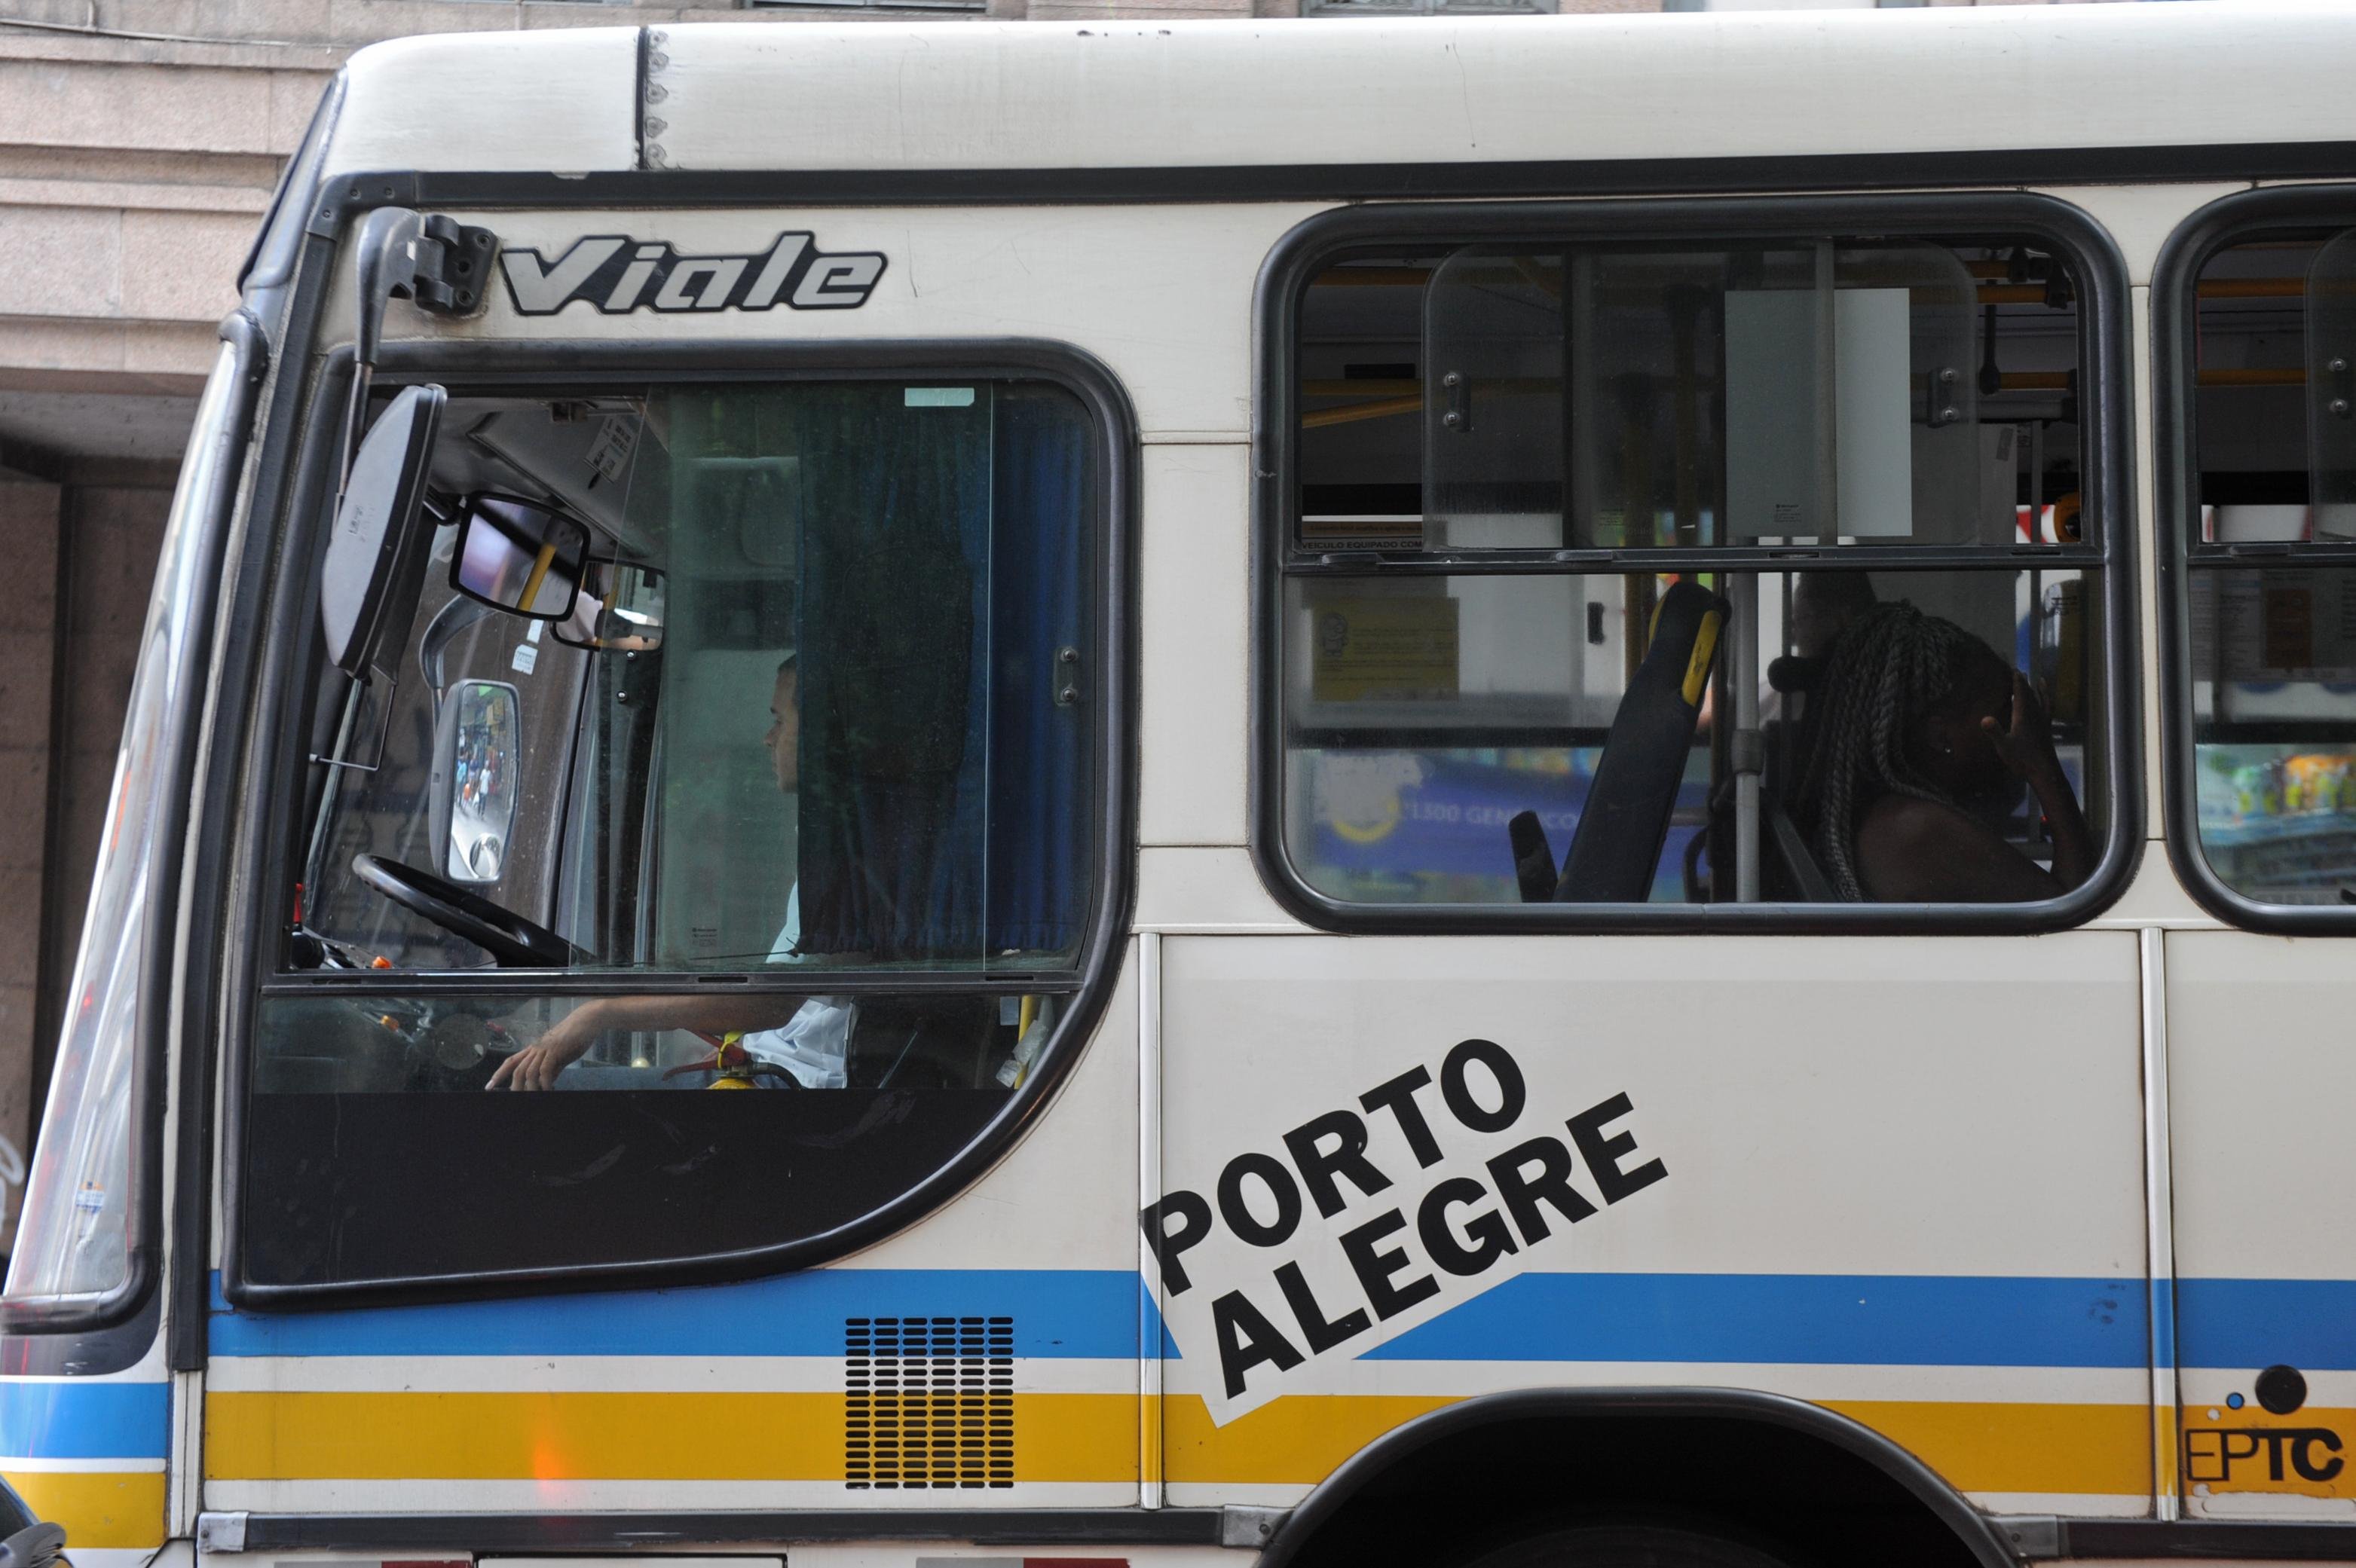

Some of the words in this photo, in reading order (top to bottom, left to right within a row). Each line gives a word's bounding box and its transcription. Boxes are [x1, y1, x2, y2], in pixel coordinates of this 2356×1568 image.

[501, 231, 888, 316] Viale
[1347, 540, 1398, 549] EQUIPADO
[1400, 540, 1423, 549] COM
[1140, 1038, 1526, 1298] PORTO
[1211, 1091, 1669, 1401] ALEGRE
[2186, 1428, 2345, 1482] EPTC
